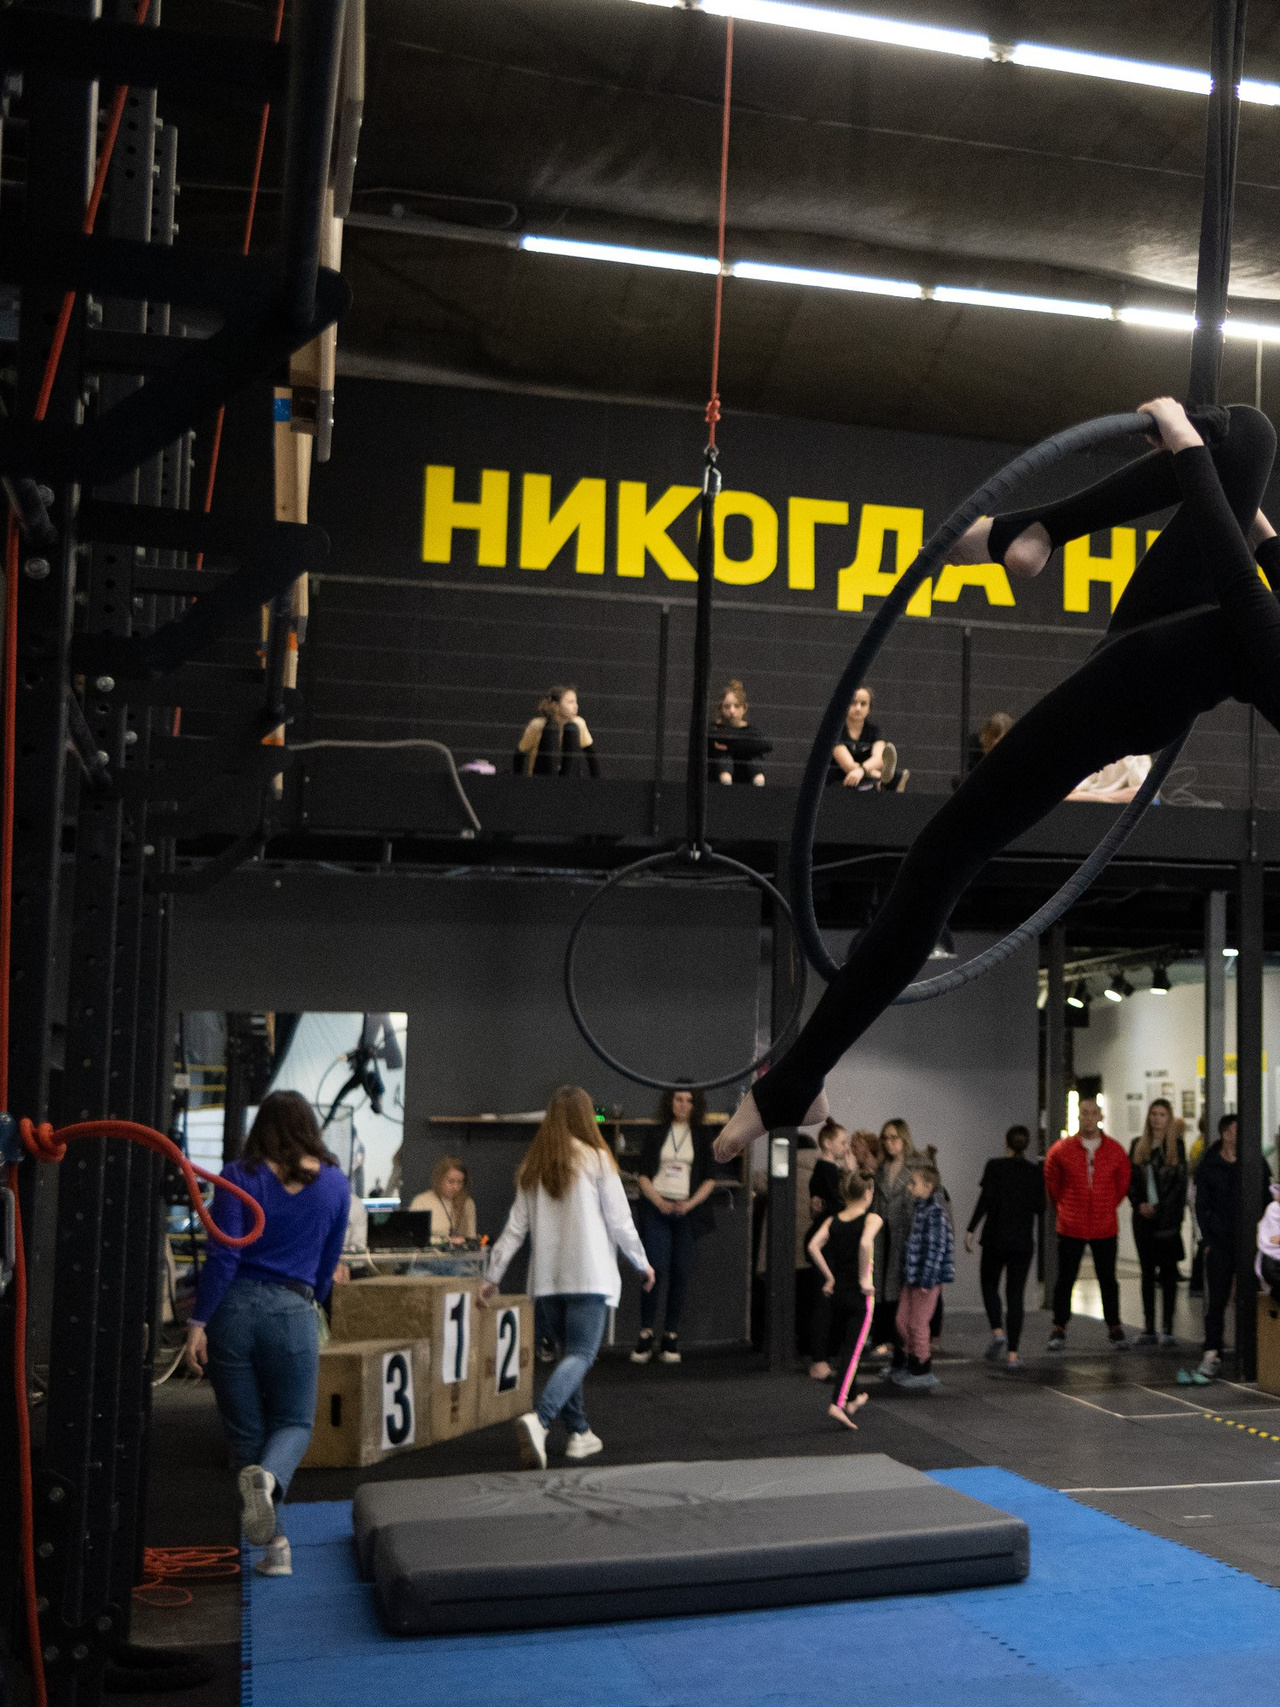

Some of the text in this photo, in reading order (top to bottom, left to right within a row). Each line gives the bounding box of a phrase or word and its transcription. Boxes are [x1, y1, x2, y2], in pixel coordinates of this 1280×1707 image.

[421, 465, 1017, 618] НИКОГДА
[1062, 526, 1163, 615] Н
[450, 1293, 465, 1381] 1
[499, 1310, 518, 1393] 2
[385, 1354, 412, 1445] 3
